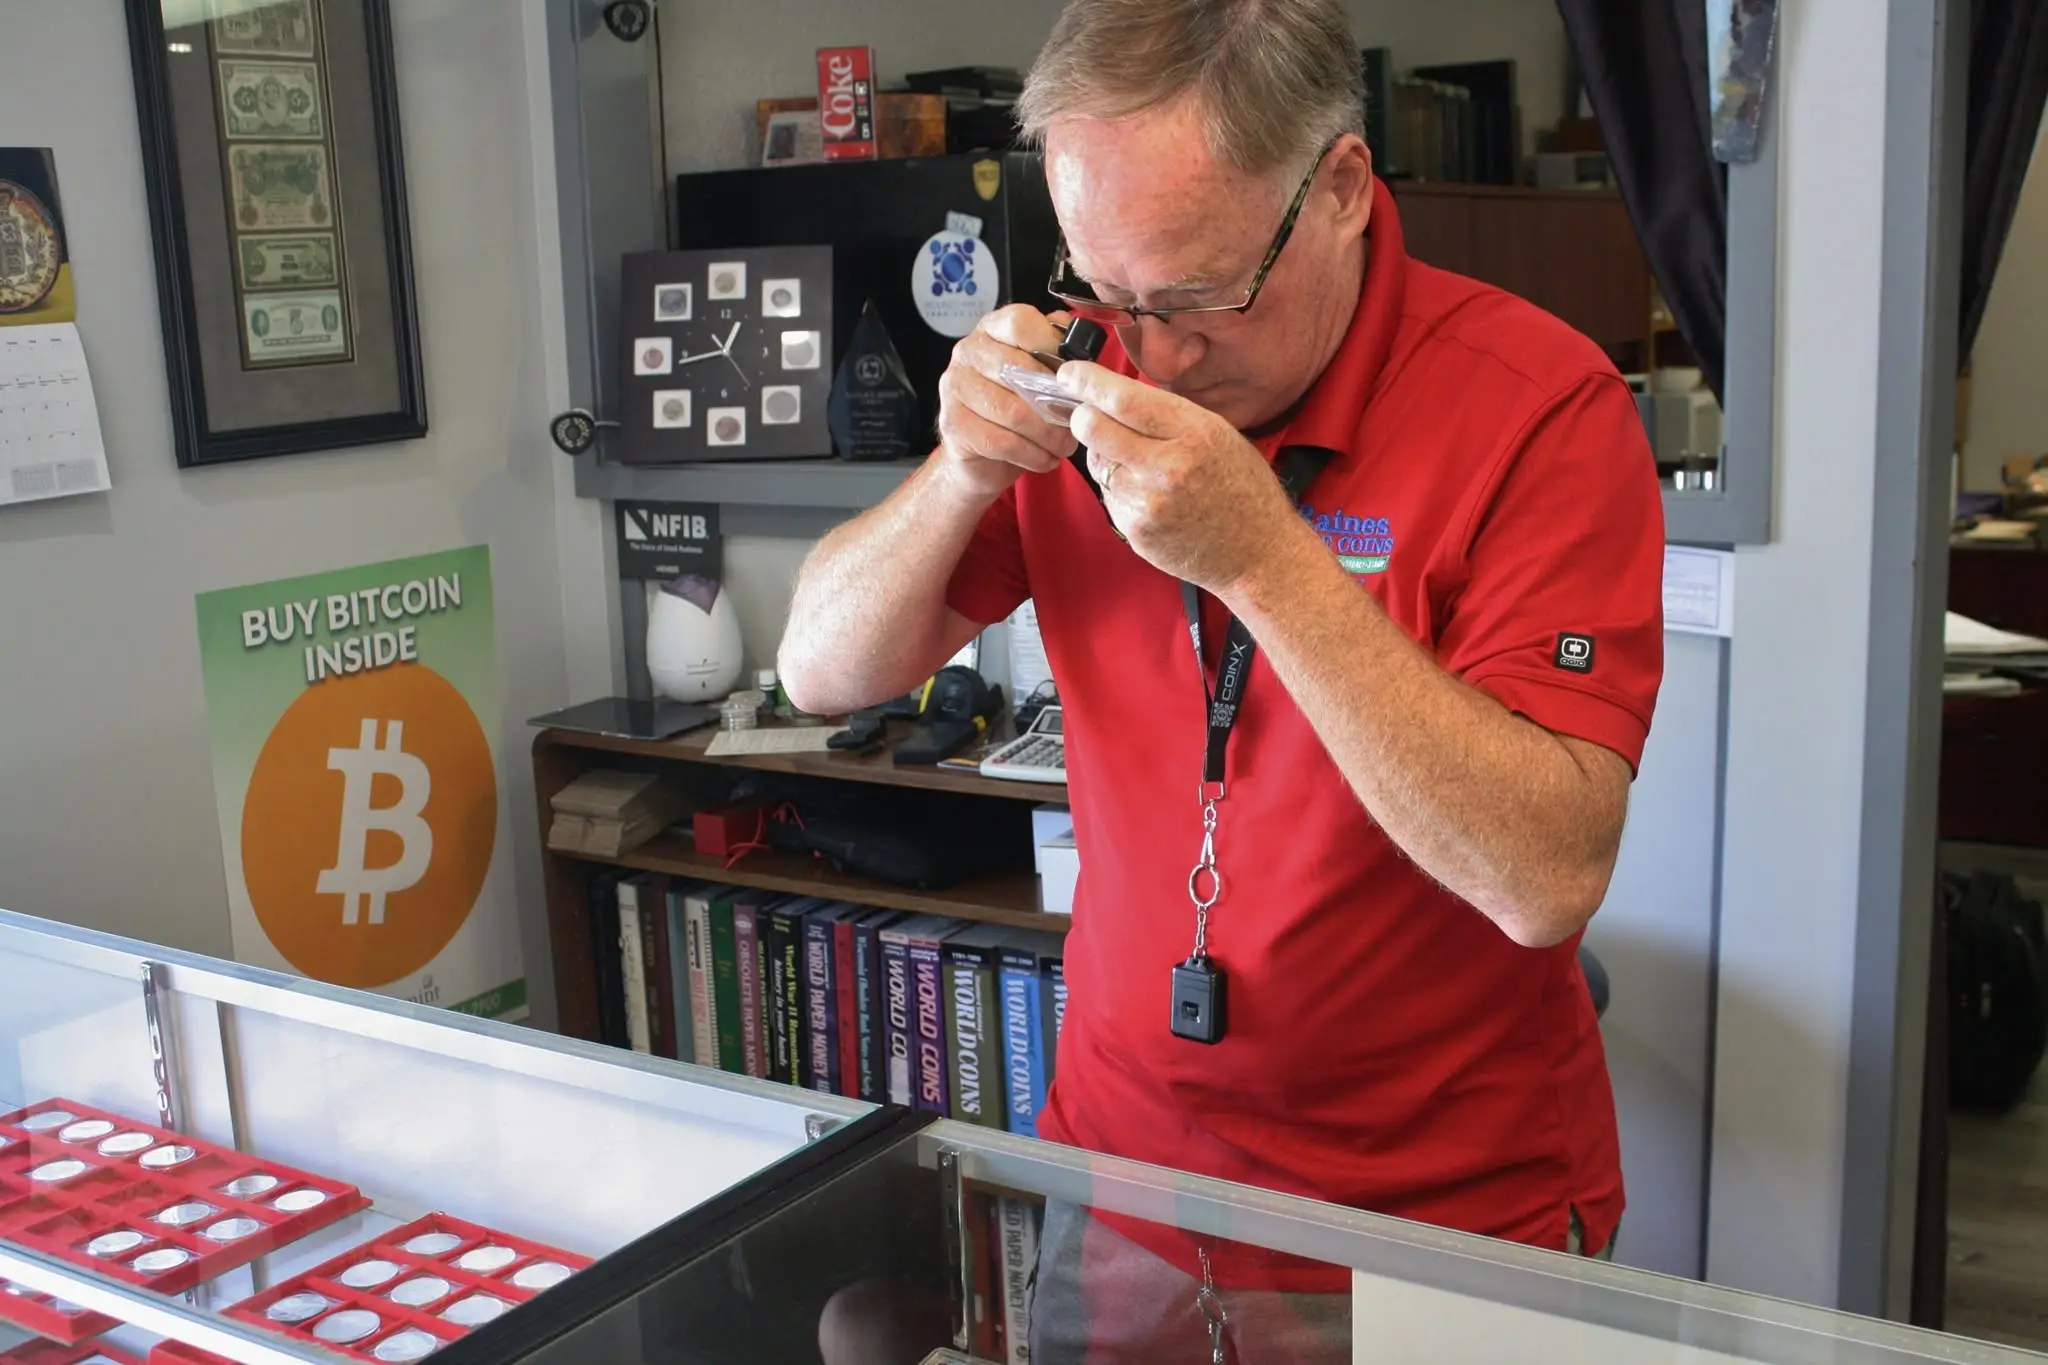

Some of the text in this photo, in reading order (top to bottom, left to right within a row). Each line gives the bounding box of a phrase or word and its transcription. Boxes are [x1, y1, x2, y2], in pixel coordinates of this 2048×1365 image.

[822, 55, 855, 140] Coke
[720, 308, 732, 319] 12
[720, 388, 728, 399] 6
[652, 513, 707, 539] NFIB
[1337, 535, 1394, 553] COINS
[241, 572, 462, 647] BUY BITCOIN
[304, 626, 418, 681] INSIDE
[740, 940, 753, 1005] OBSOLETE
[785, 944, 796, 979] World
[808, 941, 825, 986] WORLD
[787, 981, 798, 1005] War
[810, 988, 827, 1031] PAPER
[888, 959, 907, 1029] WORLD
[917, 963, 938, 1039] WORLD
[953, 970, 978, 1049] WORLD
[1006, 980, 1029, 1053] WORLD
[743, 1007, 755, 1041] PAPER
[812, 1031, 830, 1079] MONEY
[921, 1042, 941, 1104] COINS
[957, 1050, 982, 1115] COINS
[1010, 1054, 1033, 1116] COINS
[1006, 1230, 1024, 1267] PAPER
[1009, 1269, 1027, 1310] MONEY
